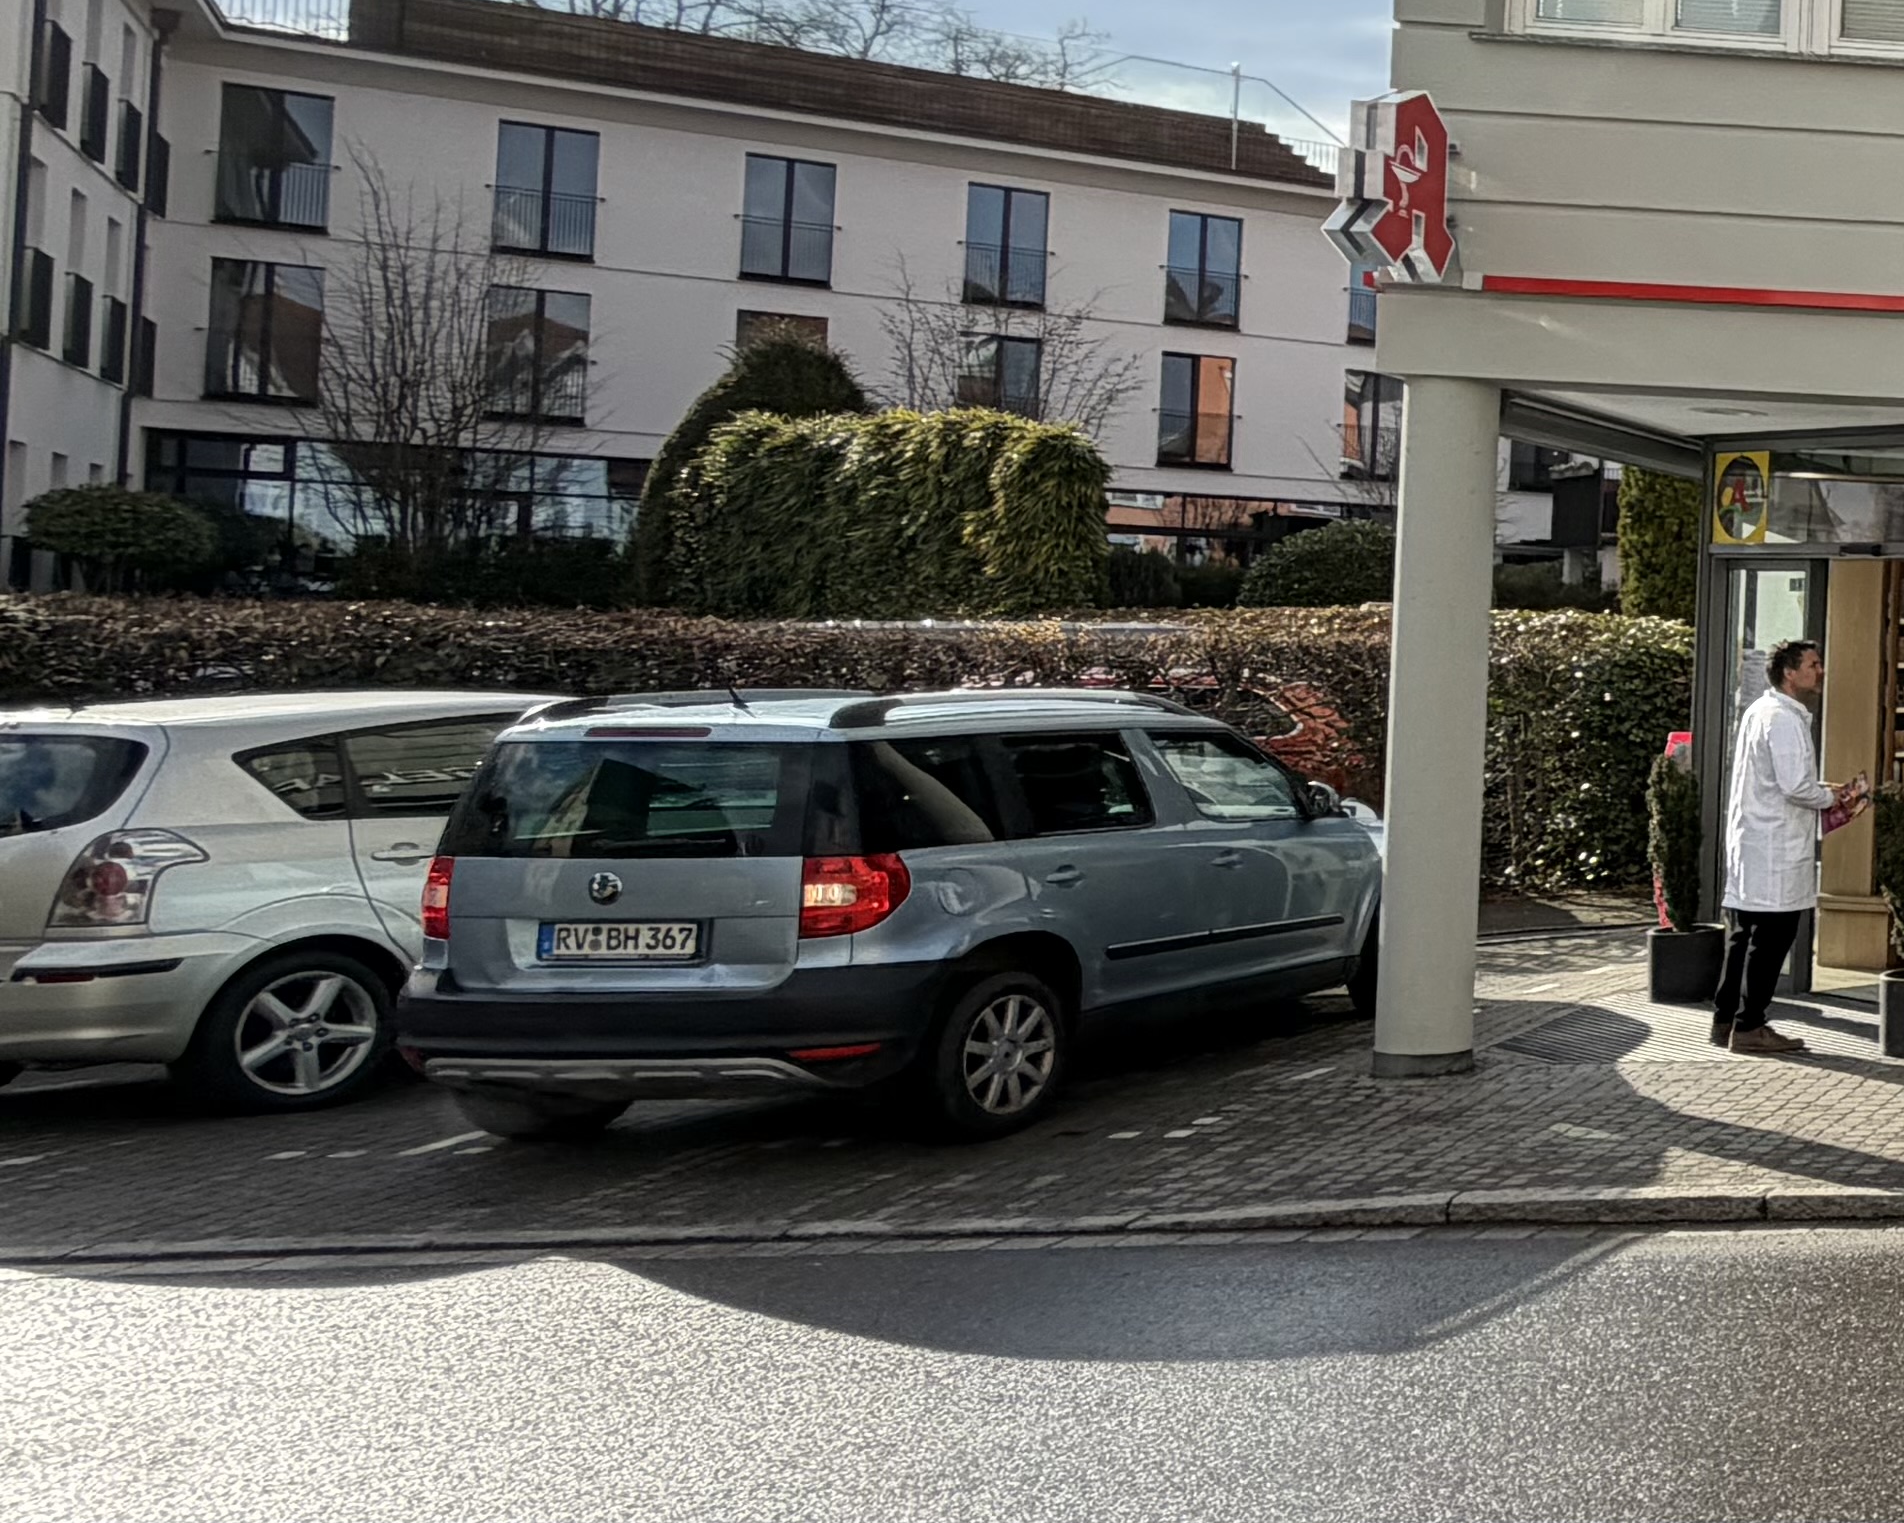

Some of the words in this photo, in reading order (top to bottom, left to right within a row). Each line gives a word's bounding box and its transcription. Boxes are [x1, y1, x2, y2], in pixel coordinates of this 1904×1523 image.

[556, 927, 590, 951] RV
[606, 927, 641, 951] BH
[645, 926, 694, 951] 367
